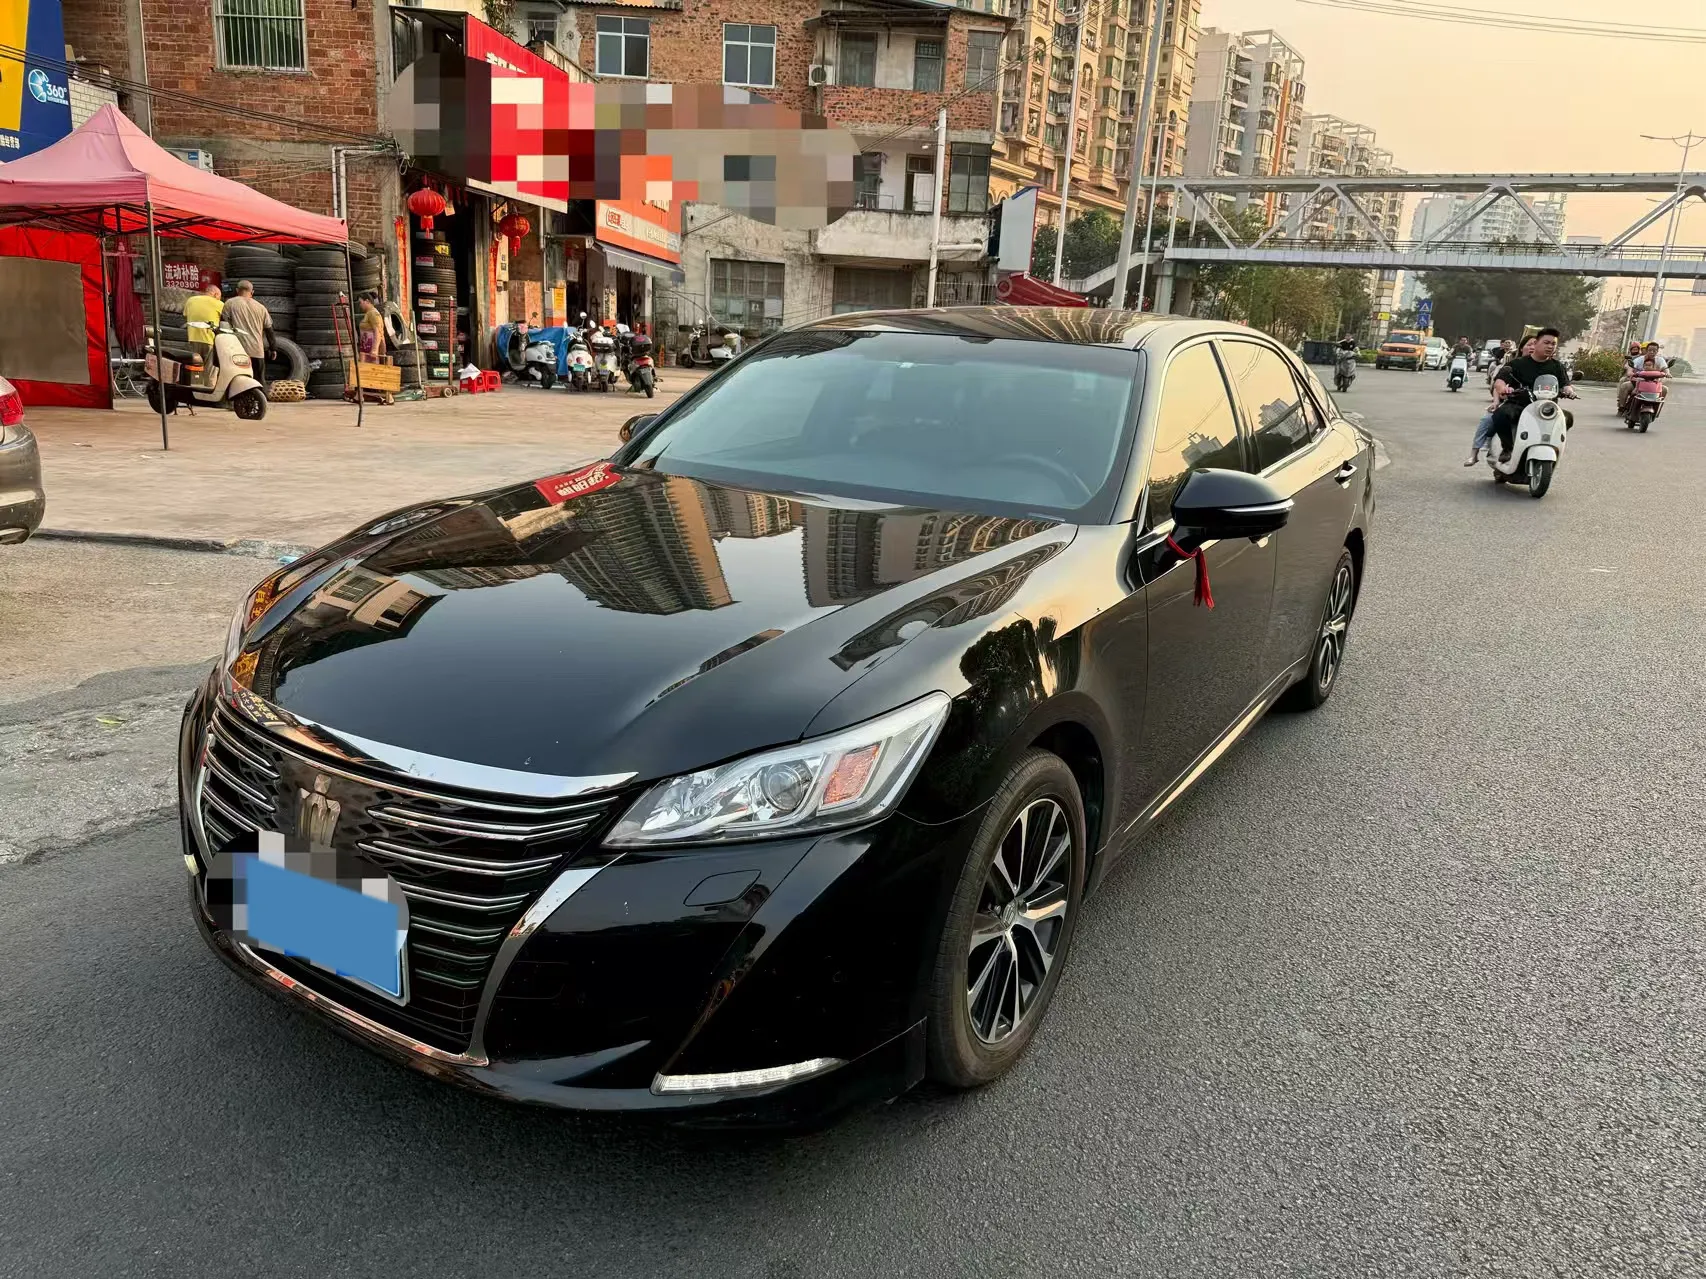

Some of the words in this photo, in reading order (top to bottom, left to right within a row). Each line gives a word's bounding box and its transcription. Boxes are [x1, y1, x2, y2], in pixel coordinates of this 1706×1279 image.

[165, 264, 199, 281] 流动补胎
[166, 280, 200, 288] 3320300
